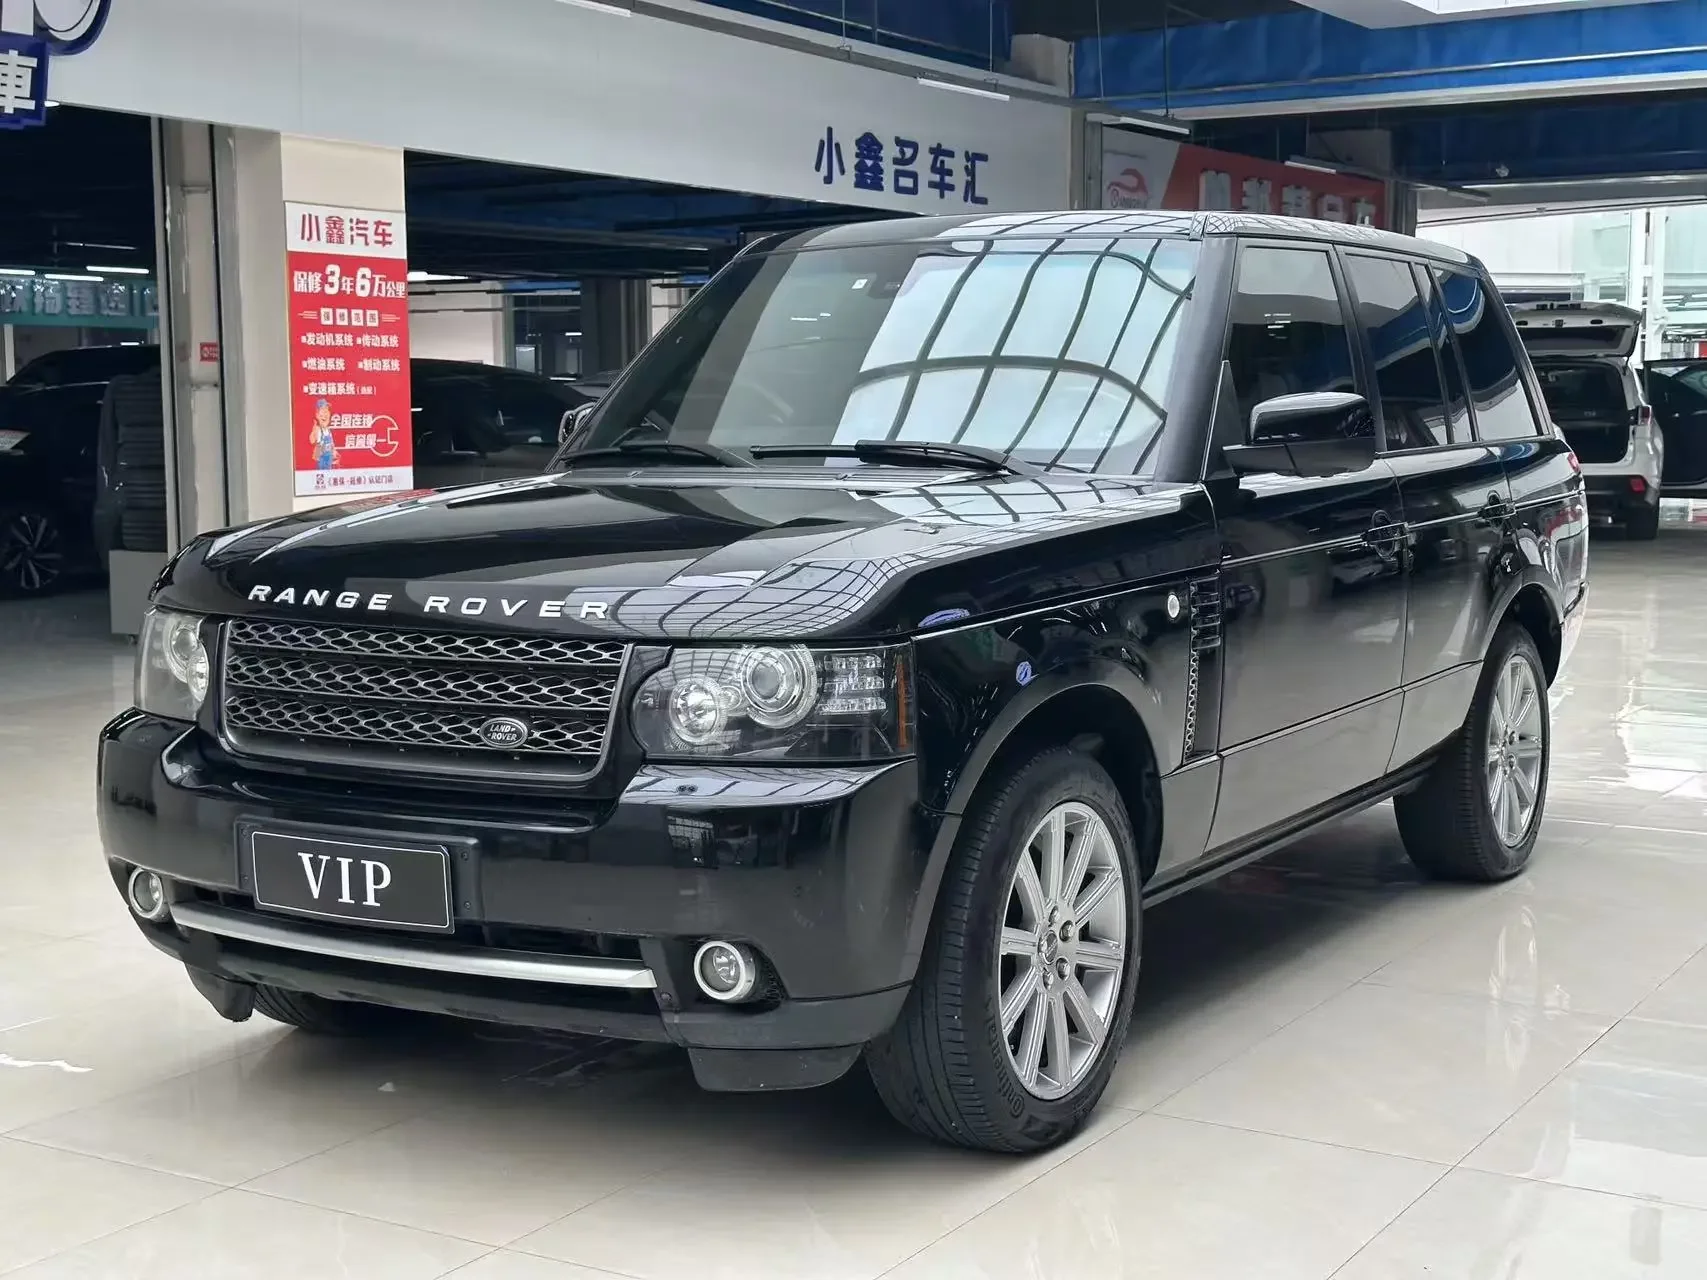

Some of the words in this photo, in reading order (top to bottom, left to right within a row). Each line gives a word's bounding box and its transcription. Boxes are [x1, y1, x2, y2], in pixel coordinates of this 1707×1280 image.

[815, 126, 989, 205] 小鑫名车汇
[301, 213, 393, 247] 小鑫汽车
[293, 264, 406, 299] 保修3年6万公里
[306, 332, 353, 347] 发动机系统
[361, 334, 399, 347] 传动系统
[248, 584, 392, 611] RANGE
[424, 595, 609, 619] ROVER
[491, 732, 518, 741] ROVER
[298, 852, 392, 907] VIP
